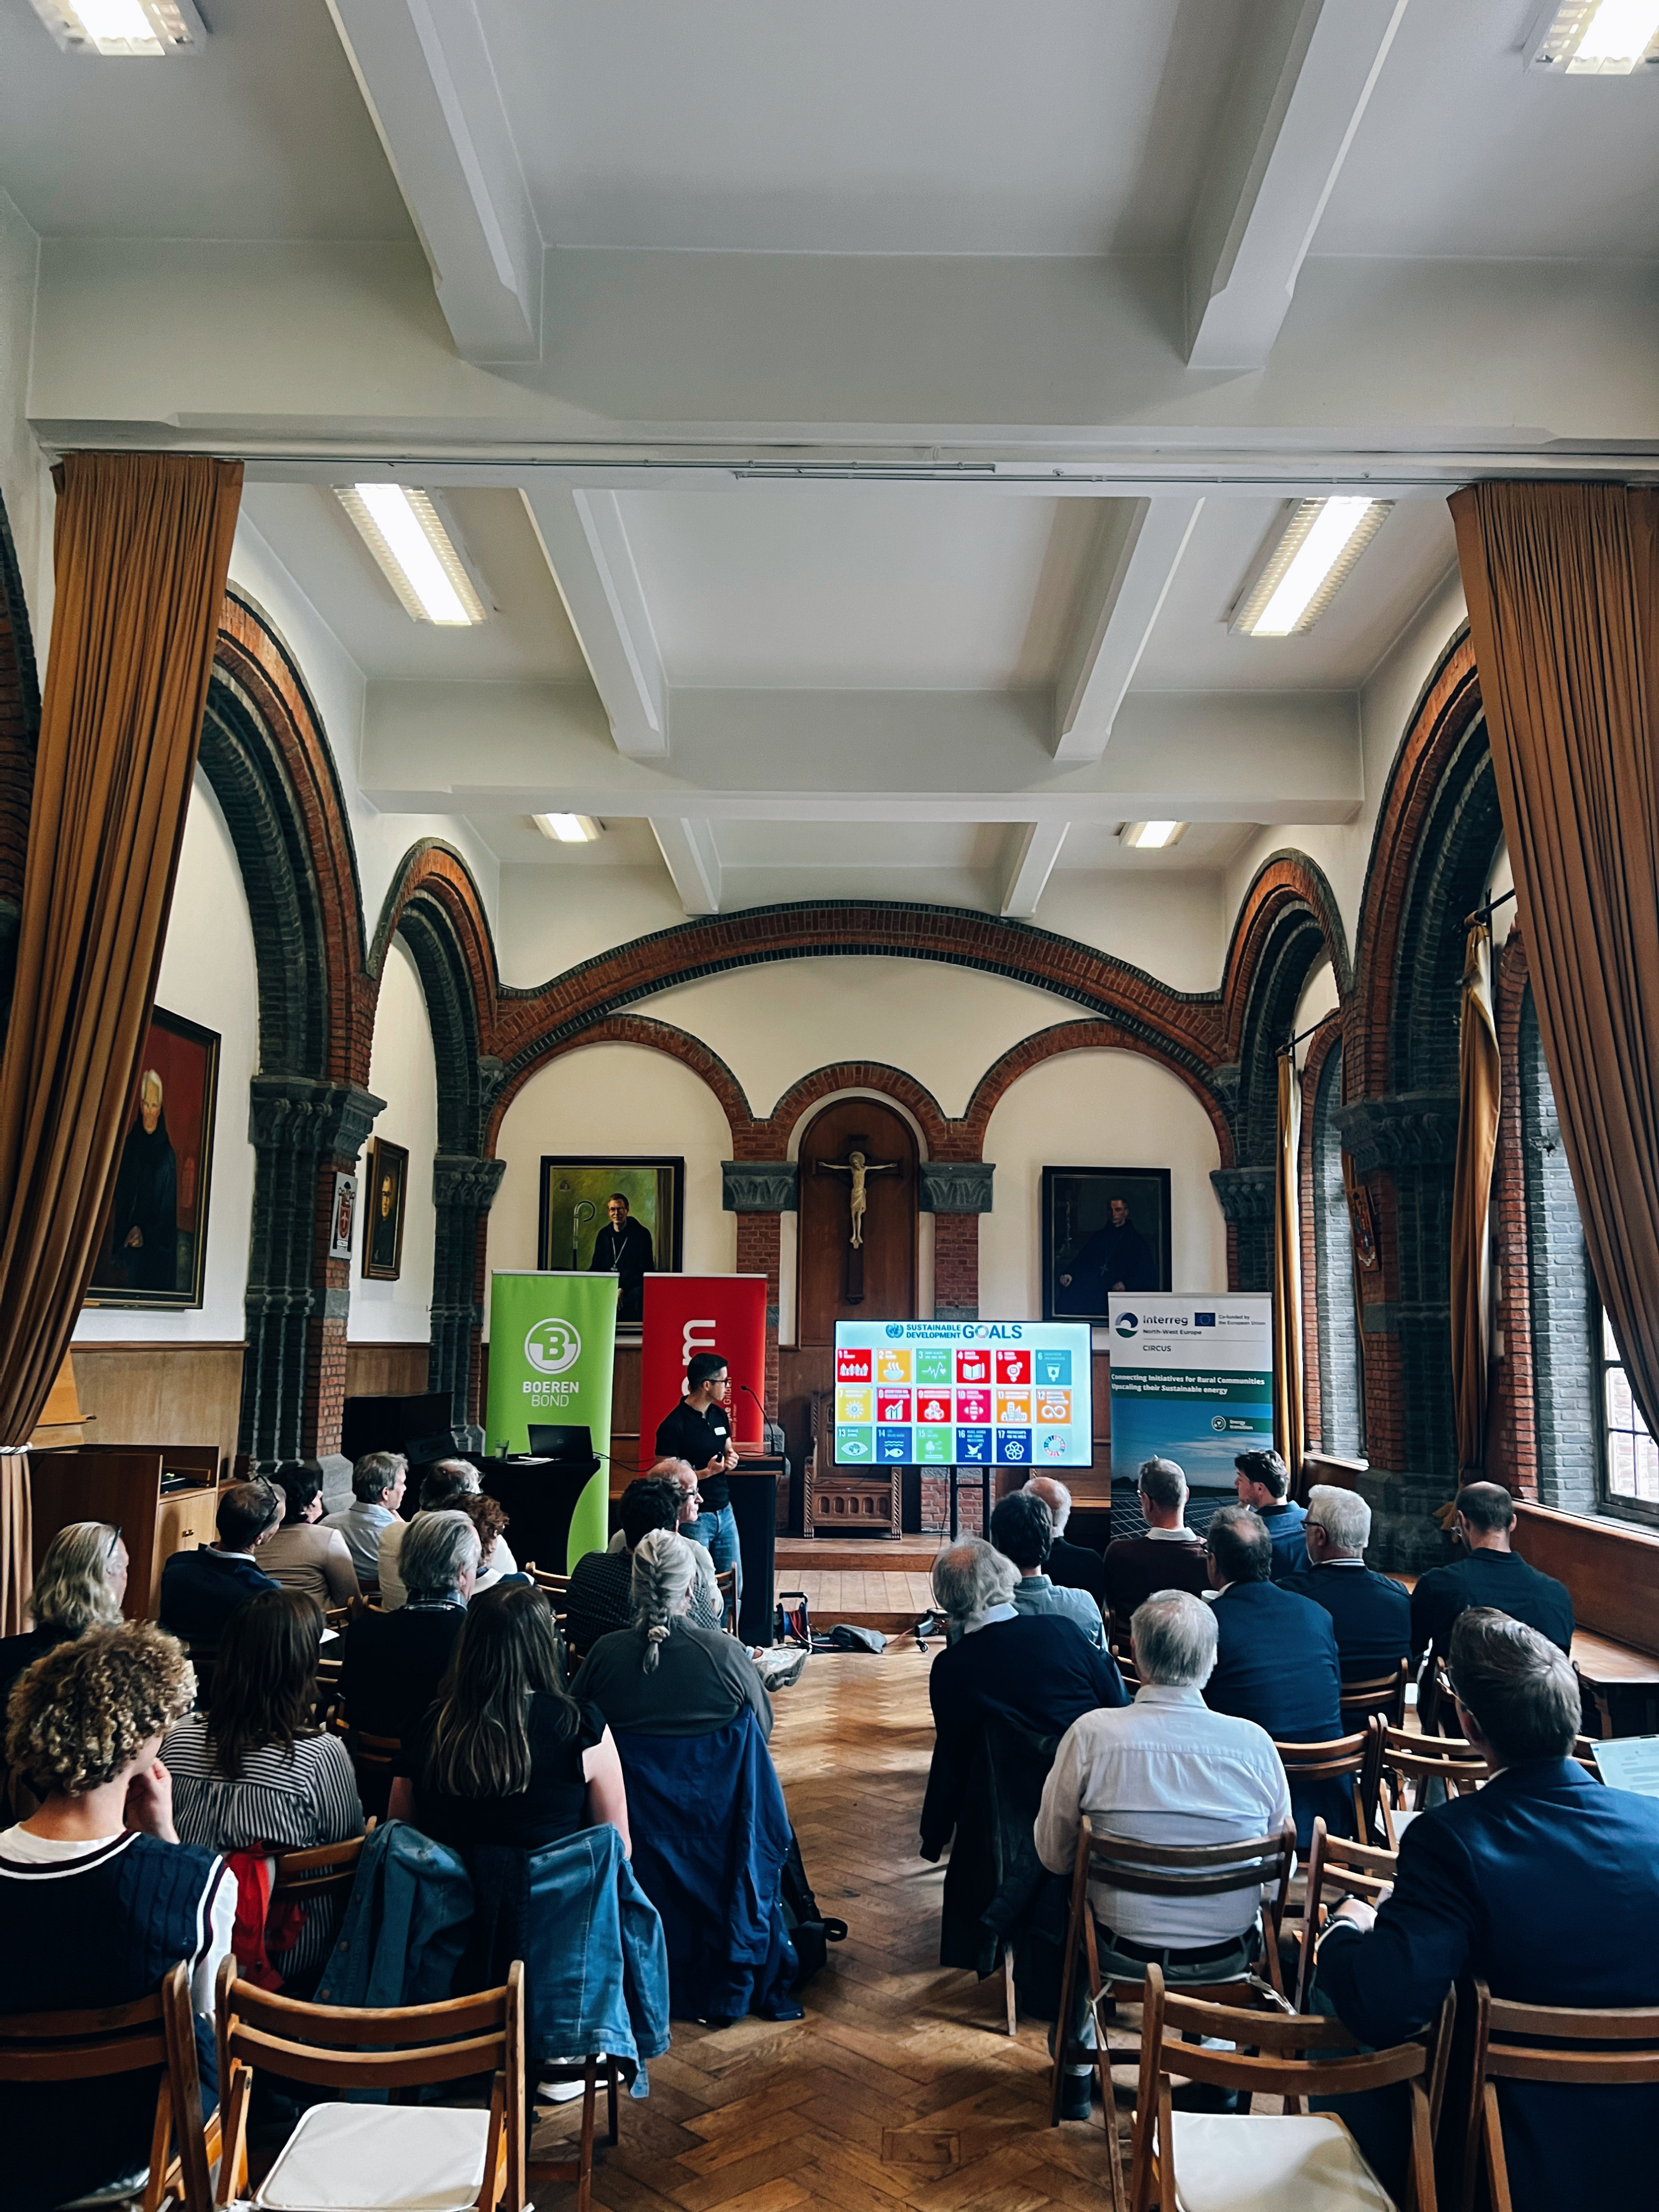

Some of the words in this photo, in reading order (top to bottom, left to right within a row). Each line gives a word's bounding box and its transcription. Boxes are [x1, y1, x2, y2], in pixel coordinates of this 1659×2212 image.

[1142, 1315, 1188, 1326] Interreg
[962, 1324, 1022, 1339] GOALS
[919, 1350, 924, 1359] 3
[958, 1351, 963, 1360] 4
[1037, 1352, 1042, 1360] 6
[1111, 1374, 1147, 1383] Connecting
[1217, 1377, 1265, 1385] Communities
[523, 1381, 580, 1394] BOEREN
[1111, 1383, 1142, 1392] Upscaling
[958, 1390, 966, 1399] 10
[1037, 1391, 1045, 1400] 12
[531, 1395, 570, 1407] BOND
[838, 1429, 846, 1437] 13
[878, 1429, 885, 1437] 14
[918, 1430, 926, 1438] 15
[958, 1430, 966, 1438] 16
[998, 1430, 1005, 1439] 17
